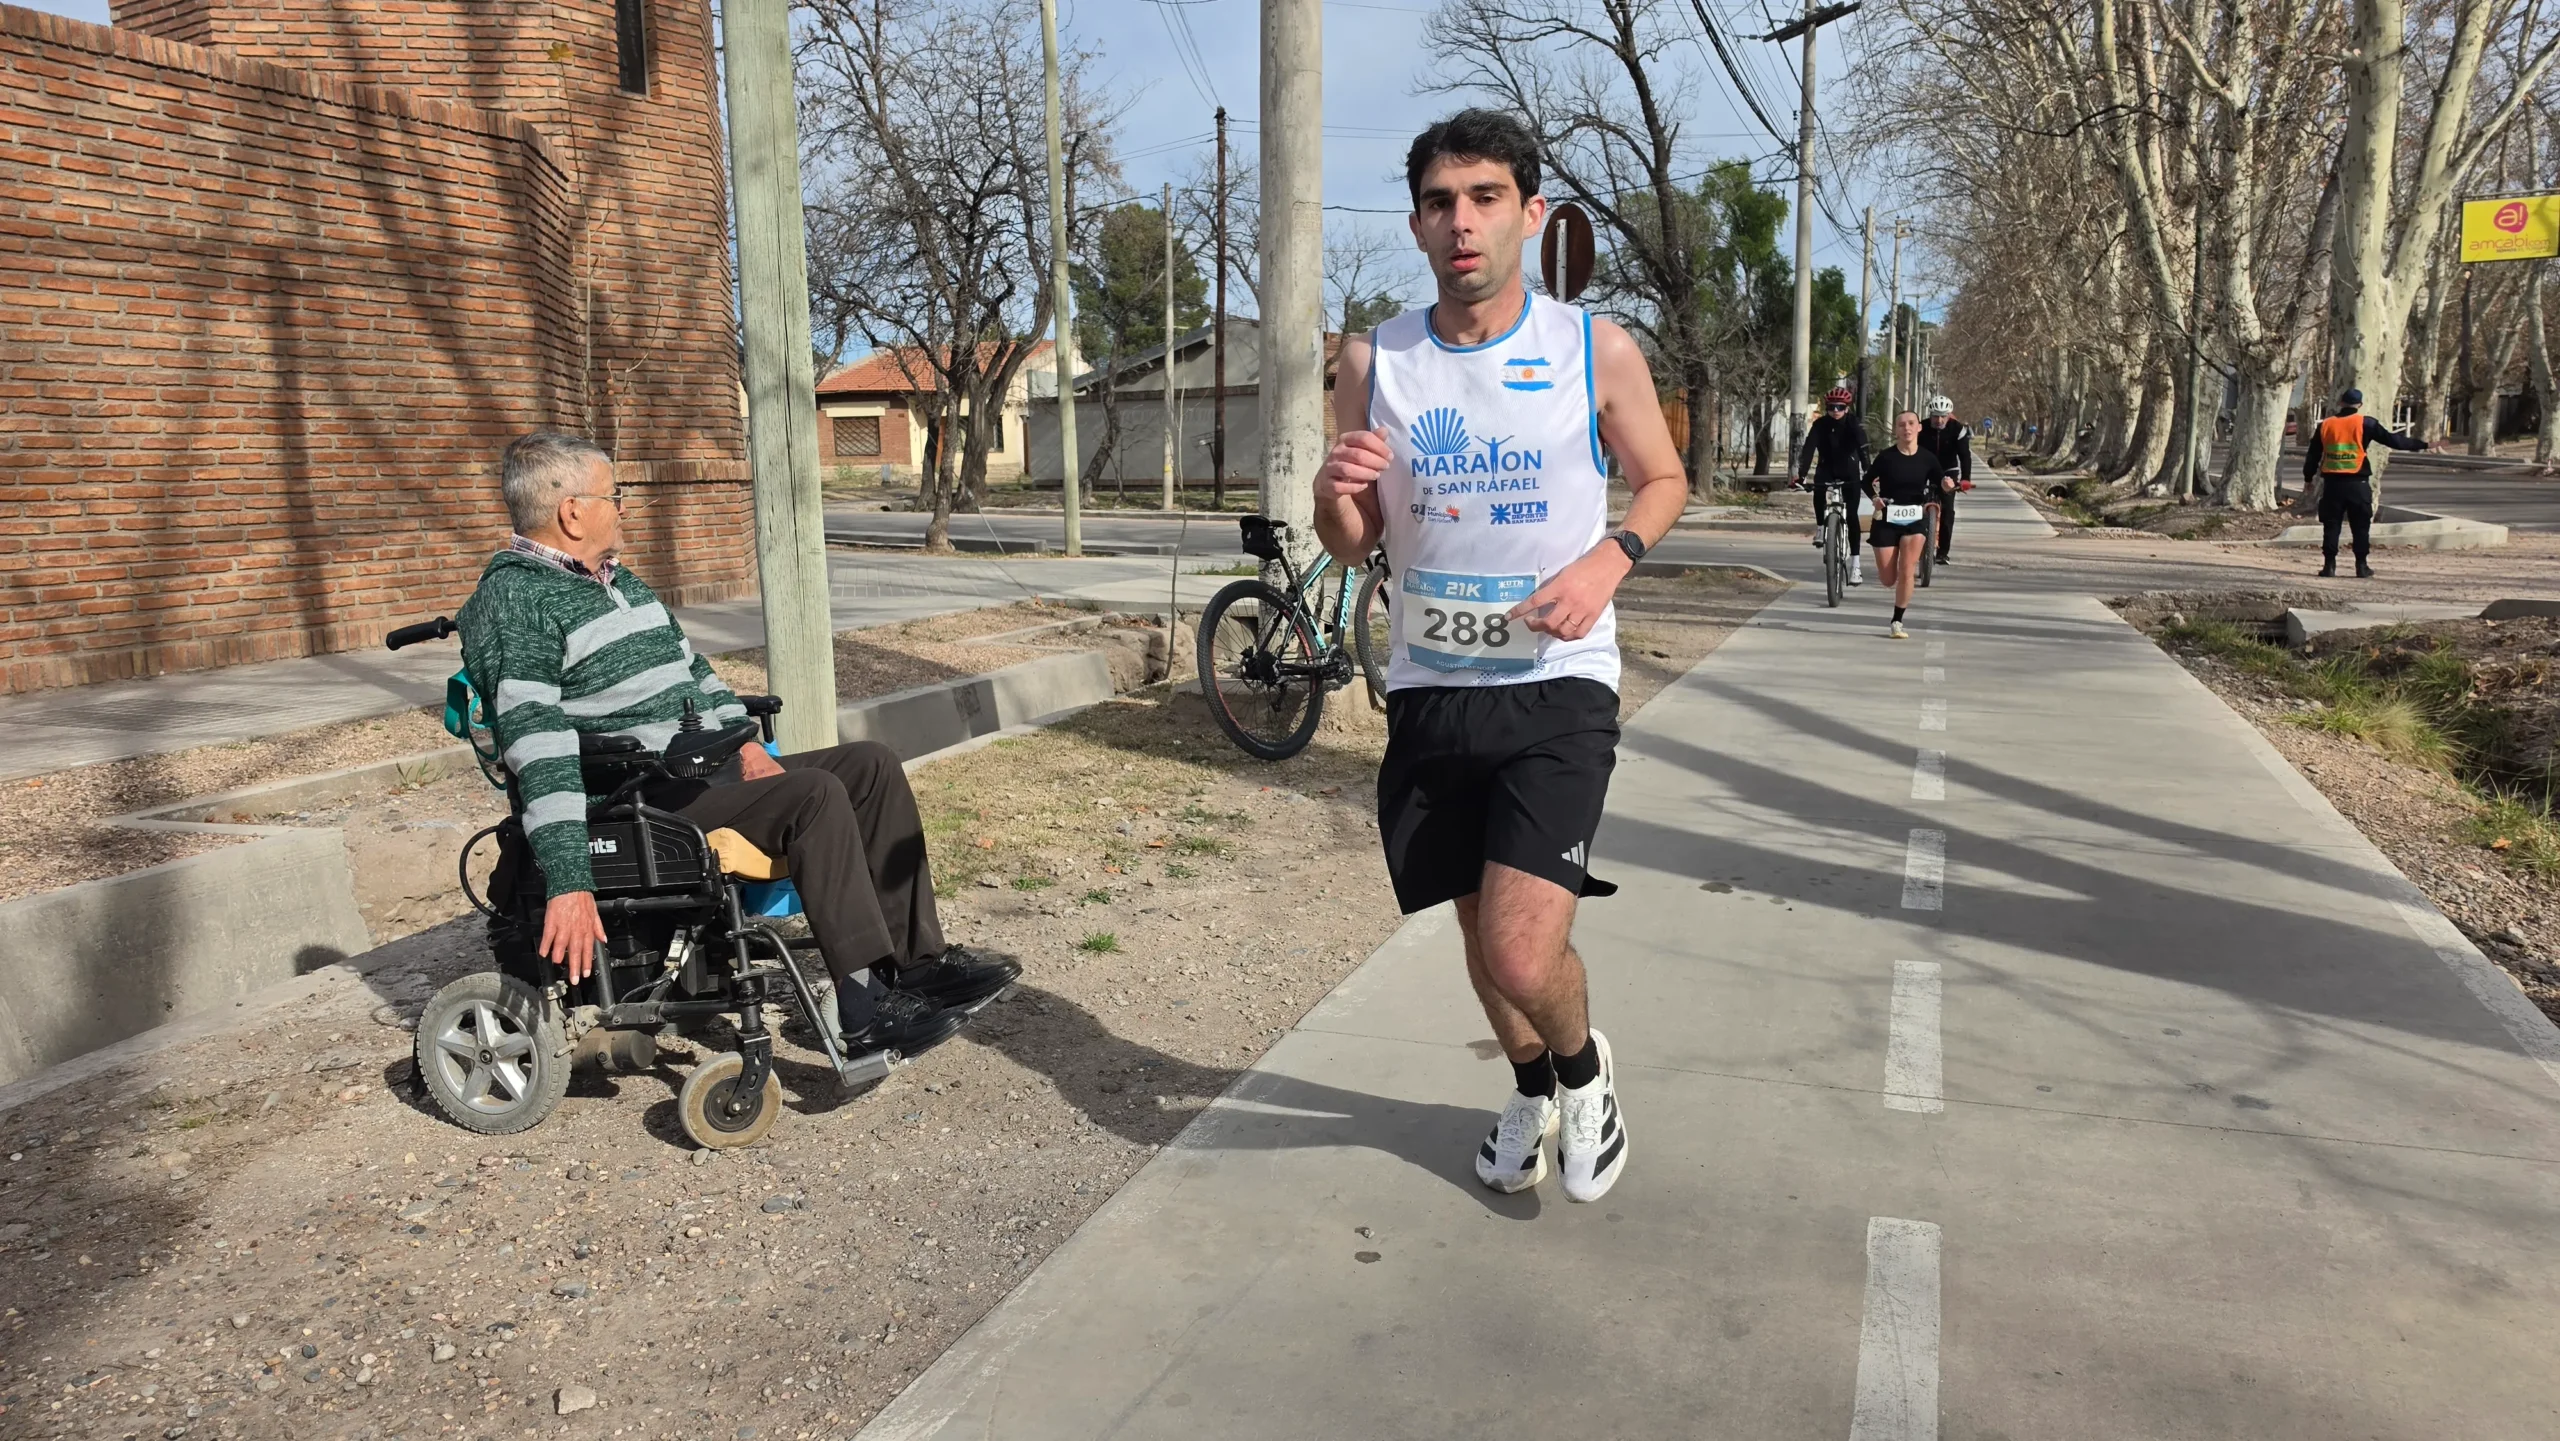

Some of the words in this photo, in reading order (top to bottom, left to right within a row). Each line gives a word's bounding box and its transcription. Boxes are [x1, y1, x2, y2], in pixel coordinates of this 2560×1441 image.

[1423, 487, 1434, 495] DE
[1438, 481, 1472, 495] SAN
[1476, 478, 1540, 493] RAFAEL
[1512, 501, 1548, 514] UTN
[1512, 512, 1548, 520] DEPORTES
[1894, 508, 1916, 517] 408
[1339, 566, 1356, 629] TOPMEG
[1445, 581, 1482, 598] 21K
[1423, 607, 1510, 648] 288
[588, 837, 617, 854] rits
